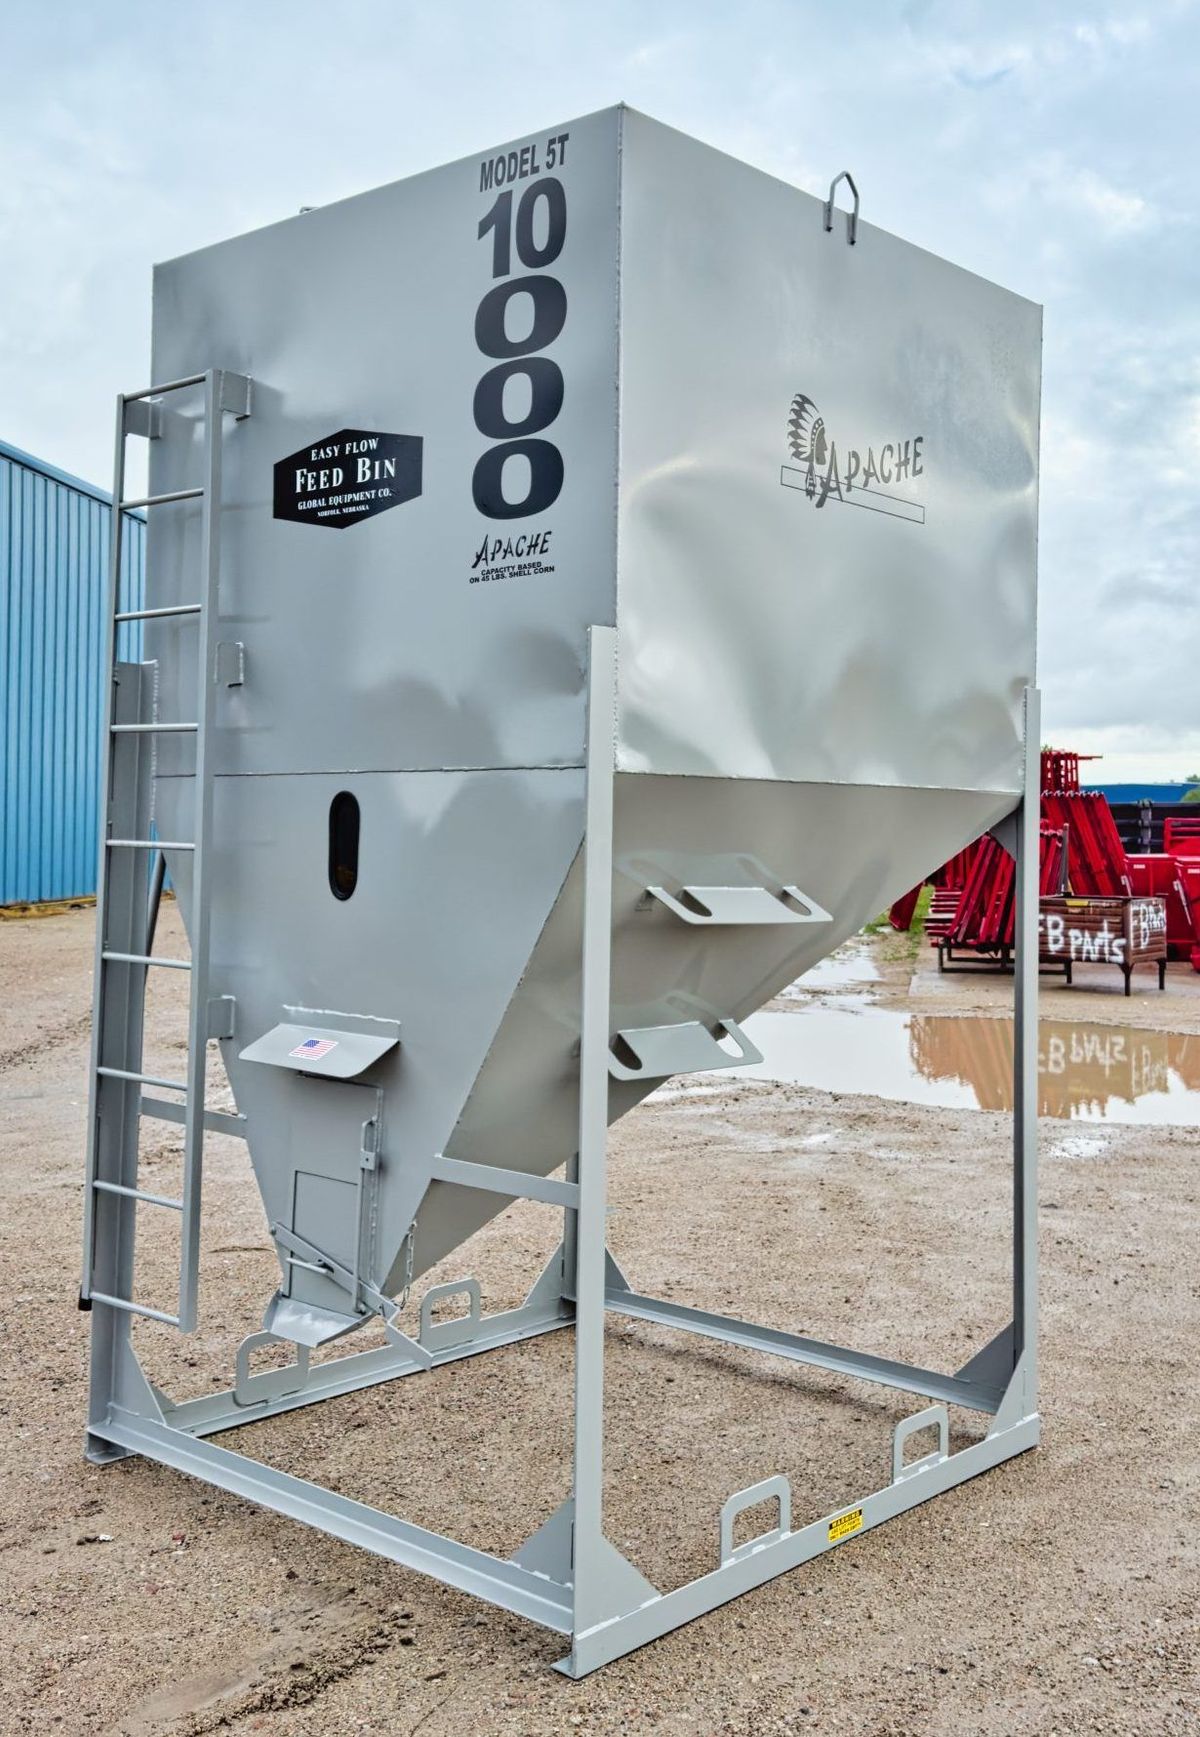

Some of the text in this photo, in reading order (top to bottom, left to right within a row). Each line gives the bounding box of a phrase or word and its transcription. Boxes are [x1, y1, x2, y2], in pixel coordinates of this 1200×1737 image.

[480, 133, 569, 193] MODEL 5T
[311, 438, 379, 461] EASY FLOW
[295, 457, 397, 493] FEED BIN
[815, 436, 924, 508] APACHE
[297, 488, 392, 510] GLOBAL EQUIPMENT CO.
[471, 531, 552, 568] APACHE
[481, 562, 542, 576] CAPACITY BASED
[492, 573, 507, 581] LBS.
[509, 570, 531, 578] SHELL
[534, 566, 554, 574] CORN
